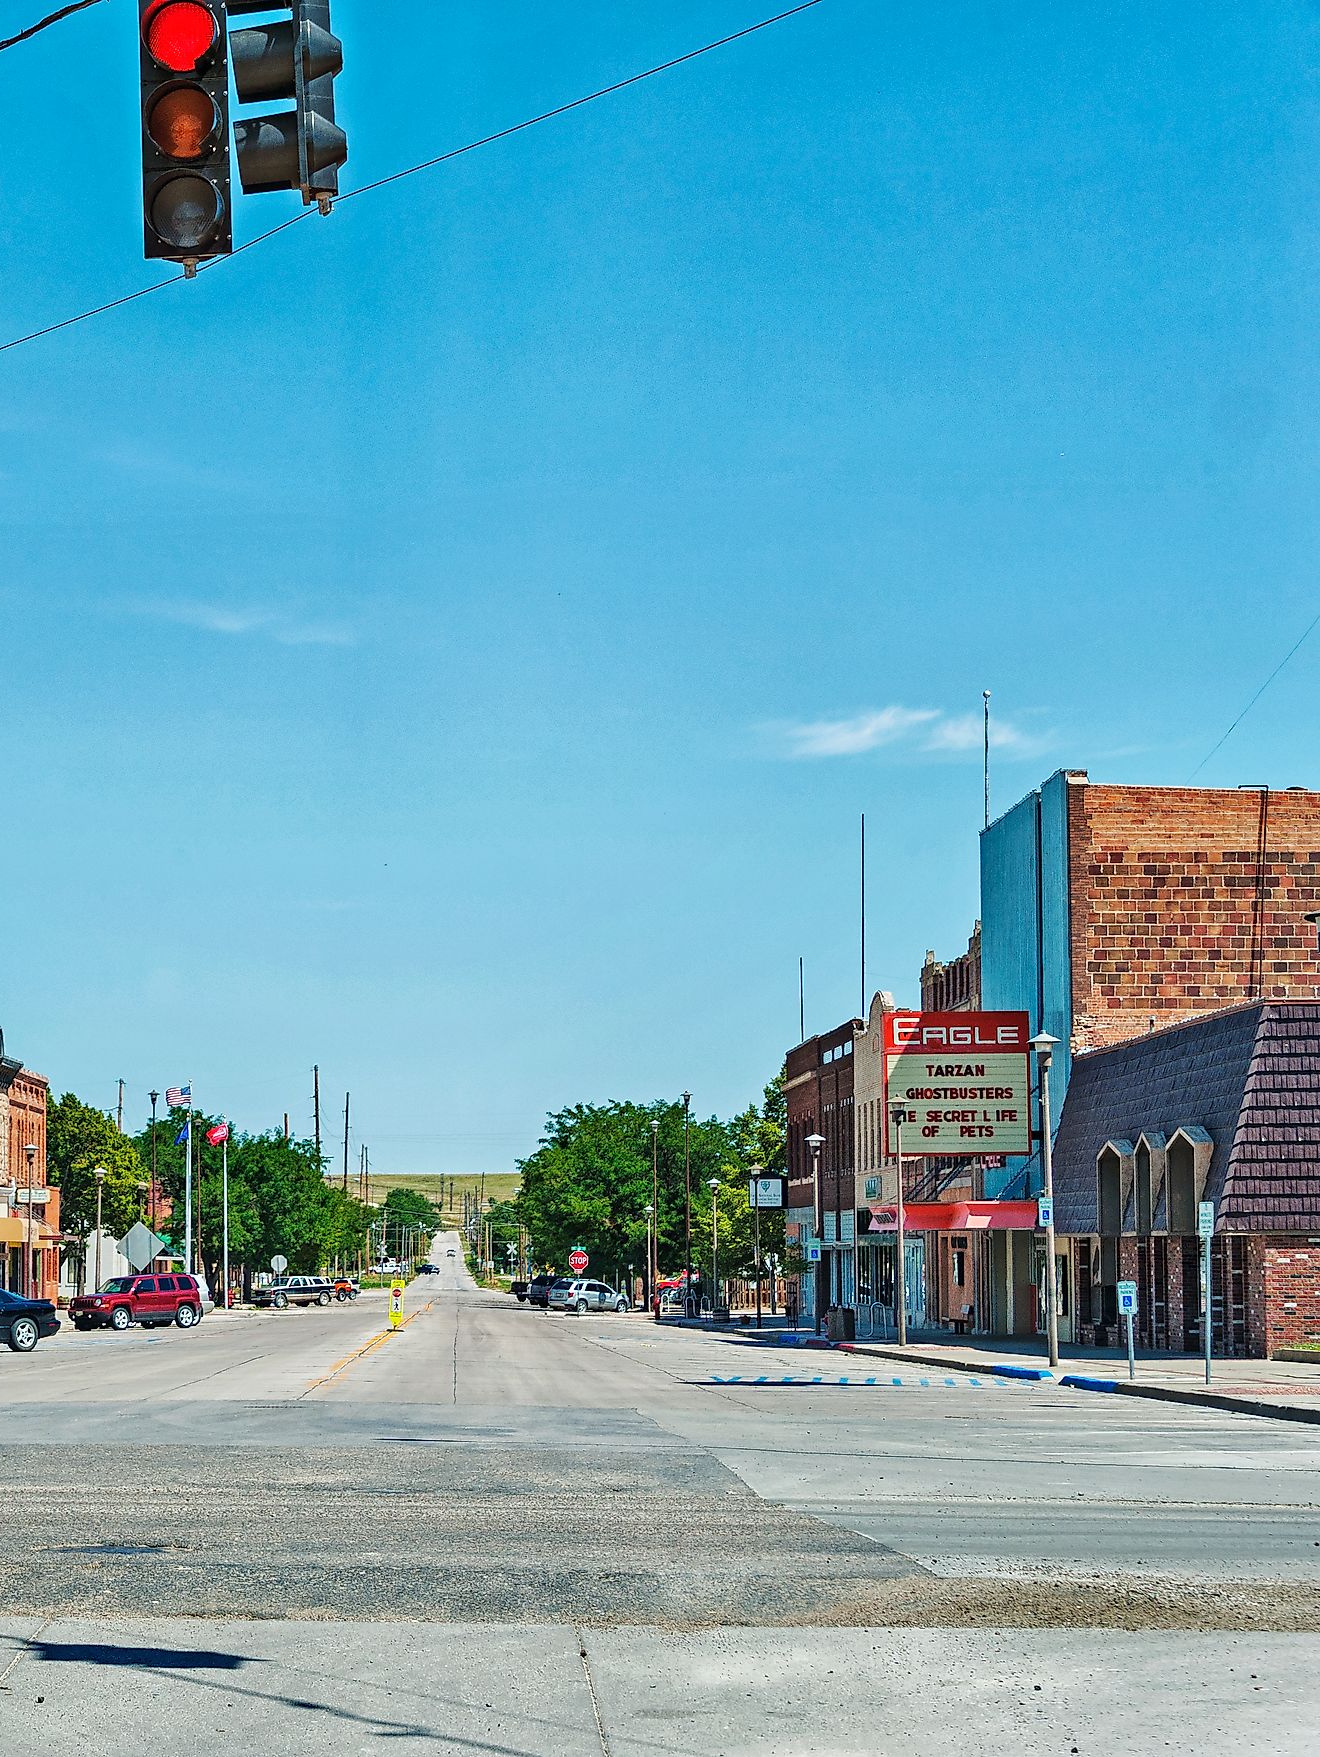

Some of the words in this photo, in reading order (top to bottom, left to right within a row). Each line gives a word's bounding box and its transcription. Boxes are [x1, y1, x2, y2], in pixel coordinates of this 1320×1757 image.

[893, 1017, 1020, 1045] EAGLE
[926, 1064, 985, 1077] TARZAN
[905, 1087, 1014, 1100] GHOSTBUSTERS
[926, 1110, 978, 1122] SECRET
[921, 1125, 940, 1138] OF
[959, 1125, 995, 1138] PETS
[570, 1256, 587, 1265] STOP
